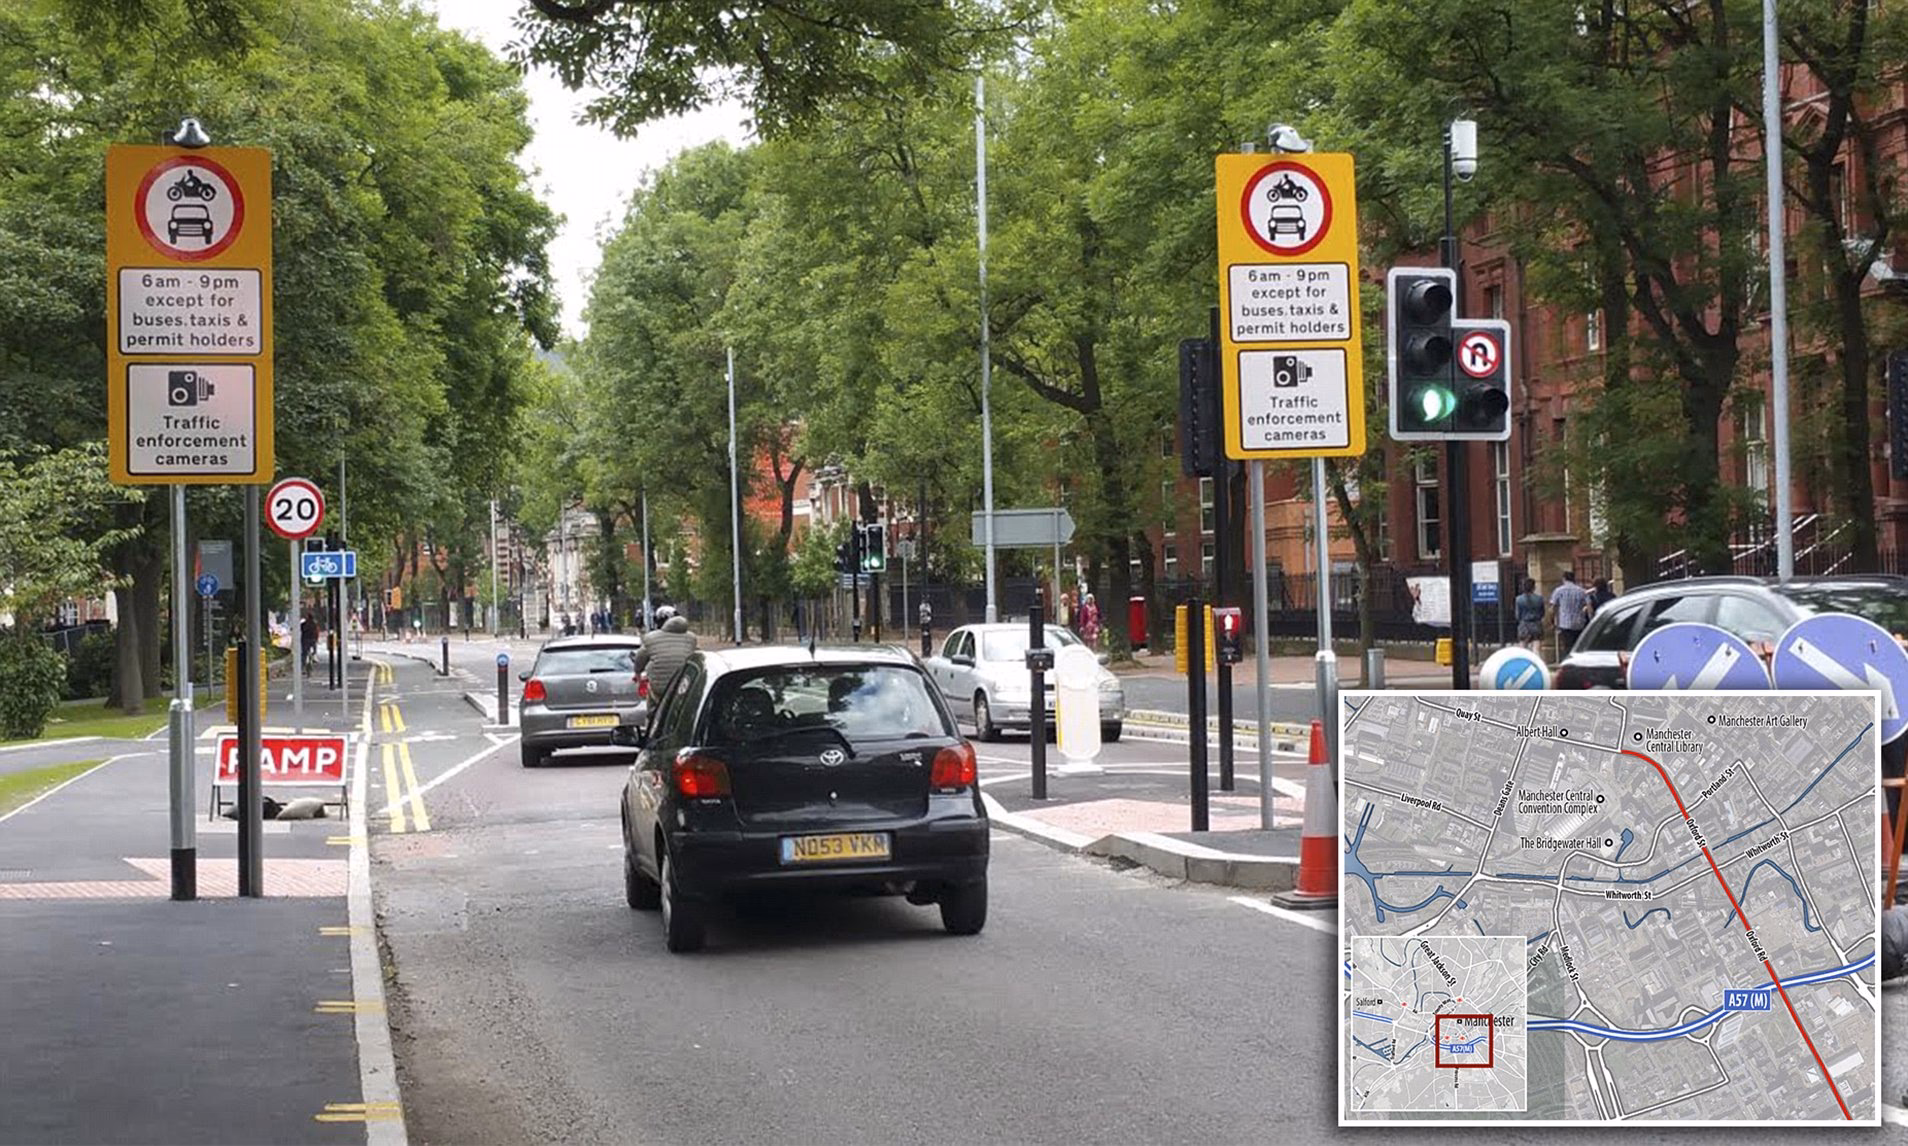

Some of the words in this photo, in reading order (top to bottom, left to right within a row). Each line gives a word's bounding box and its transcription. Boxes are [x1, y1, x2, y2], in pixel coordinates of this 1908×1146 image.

[145, 294, 204, 308] except
[210, 293, 234, 307] for
[1251, 286, 1300, 300] except
[1306, 286, 1326, 298] for
[1329, 302, 1339, 315] &
[237, 313, 248, 326] &
[1237, 322, 1286, 337] permit
[1290, 321, 1345, 334] holders
[126, 333, 183, 348] permit
[190, 333, 254, 347] holders
[1270, 395, 1318, 409] Traffic
[163, 415, 221, 430] Traffic
[1247, 411, 1342, 426] enforcement
[136, 433, 247, 448] enforcement
[1264, 430, 1326, 442] cameras
[155, 454, 228, 466] cameras
[275, 498, 316, 520] 20
